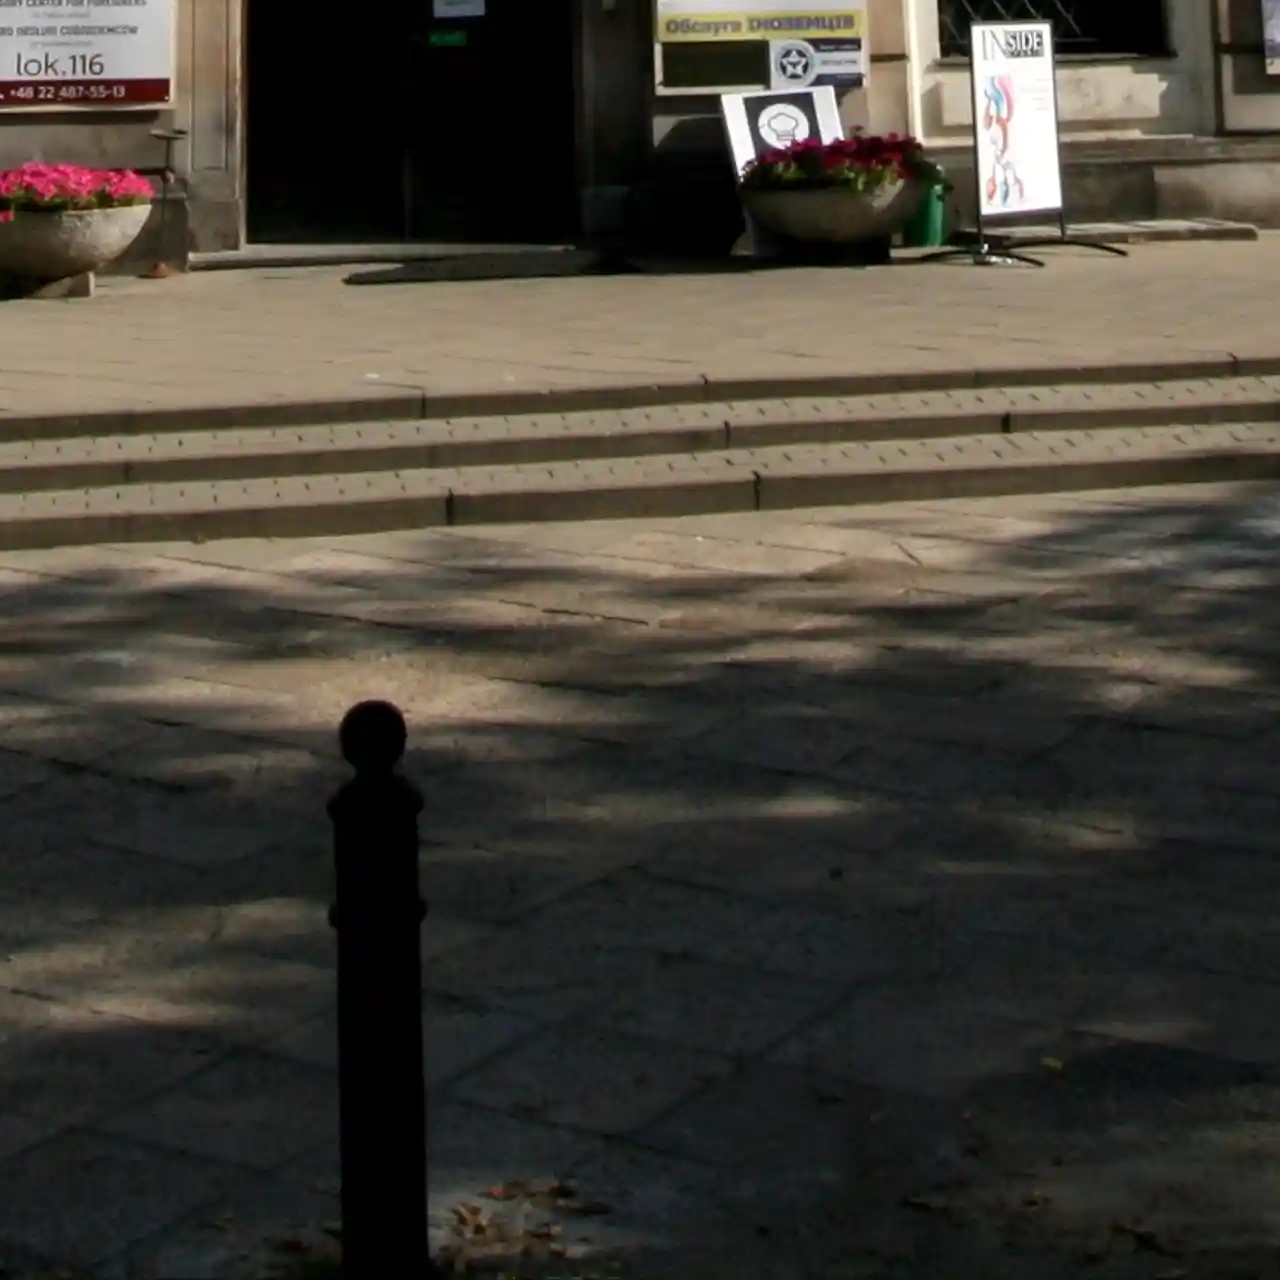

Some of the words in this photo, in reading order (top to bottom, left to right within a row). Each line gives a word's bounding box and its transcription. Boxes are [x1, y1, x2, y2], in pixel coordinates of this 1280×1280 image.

[16, 52, 105, 76] lok.116
[10, 86, 35, 98] +48
[38, 86, 55, 99] 22
